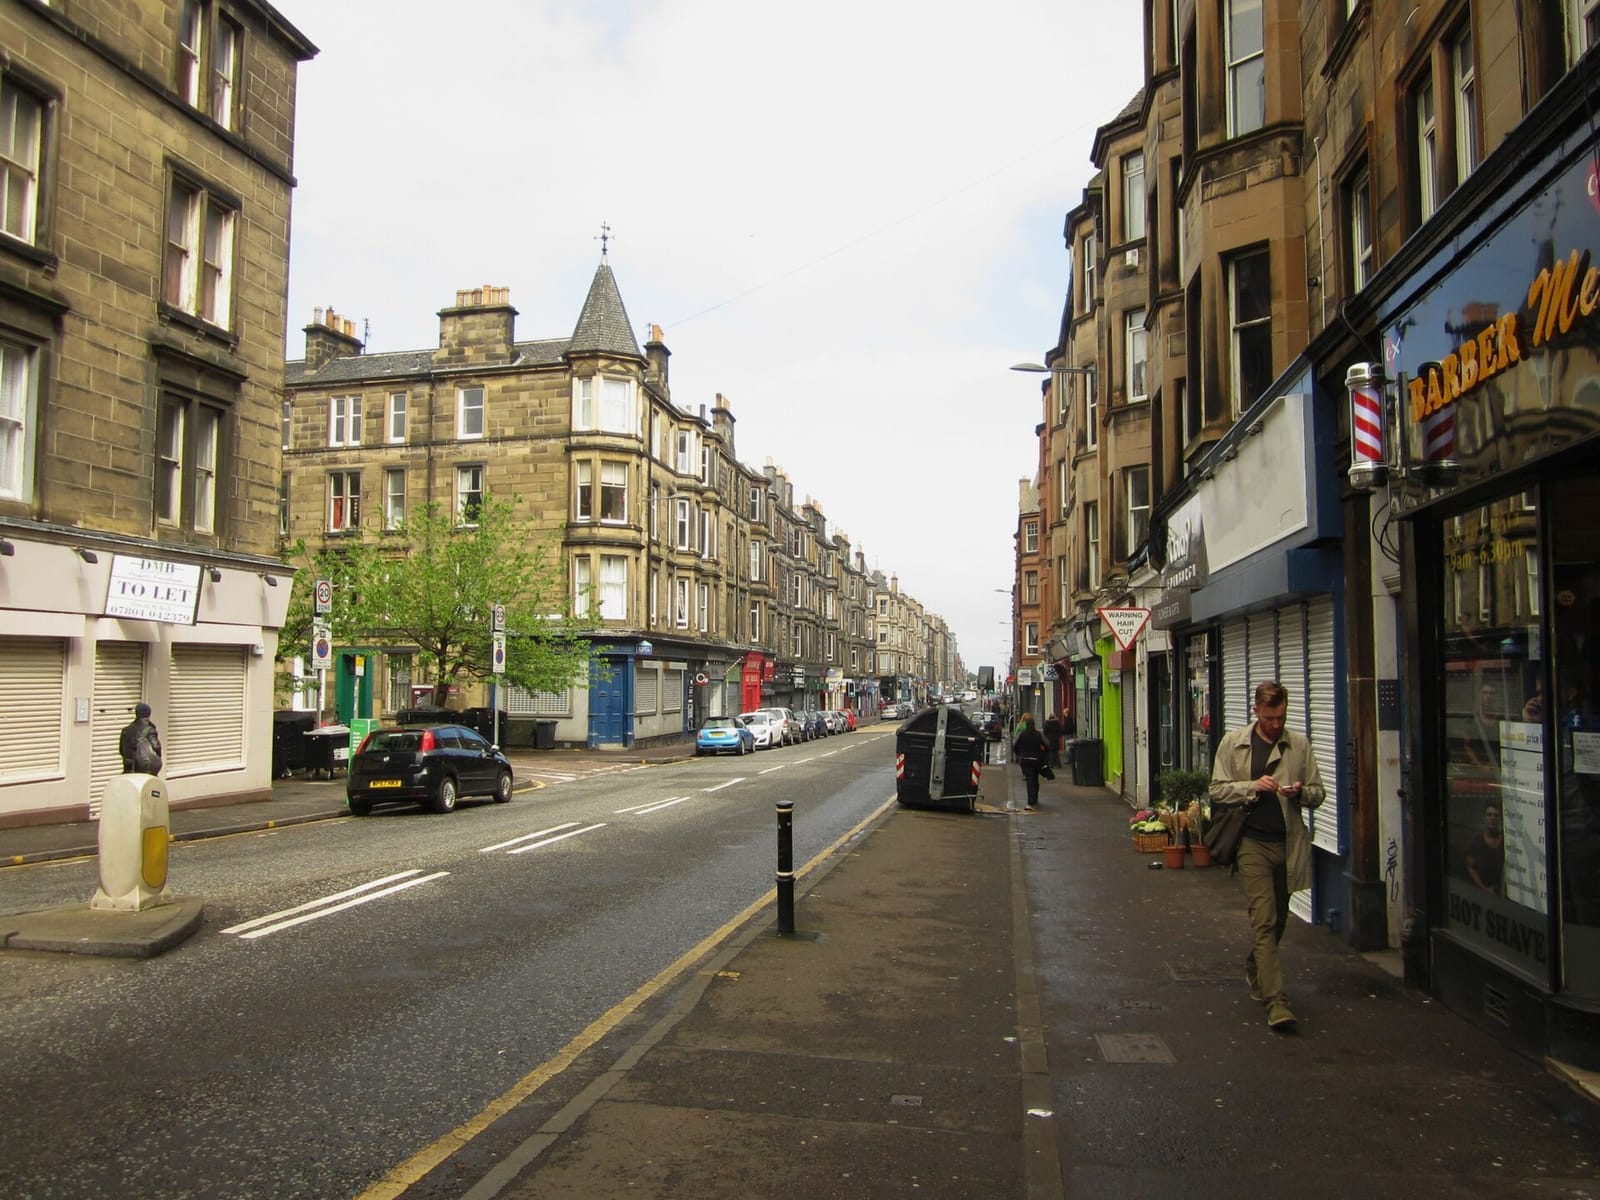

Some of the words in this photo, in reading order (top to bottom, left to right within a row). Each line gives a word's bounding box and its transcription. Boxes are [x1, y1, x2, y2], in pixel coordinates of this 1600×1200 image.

[1408, 312, 1520, 422] BARBER
[117, 580, 146, 597] TO
[153, 585, 192, 603] LET
[319, 587, 329, 598] 20
[1107, 611, 1143, 619] WARNING
[1449, 893, 1482, 932] HOT
[1486, 909, 1547, 963] SHAVE
